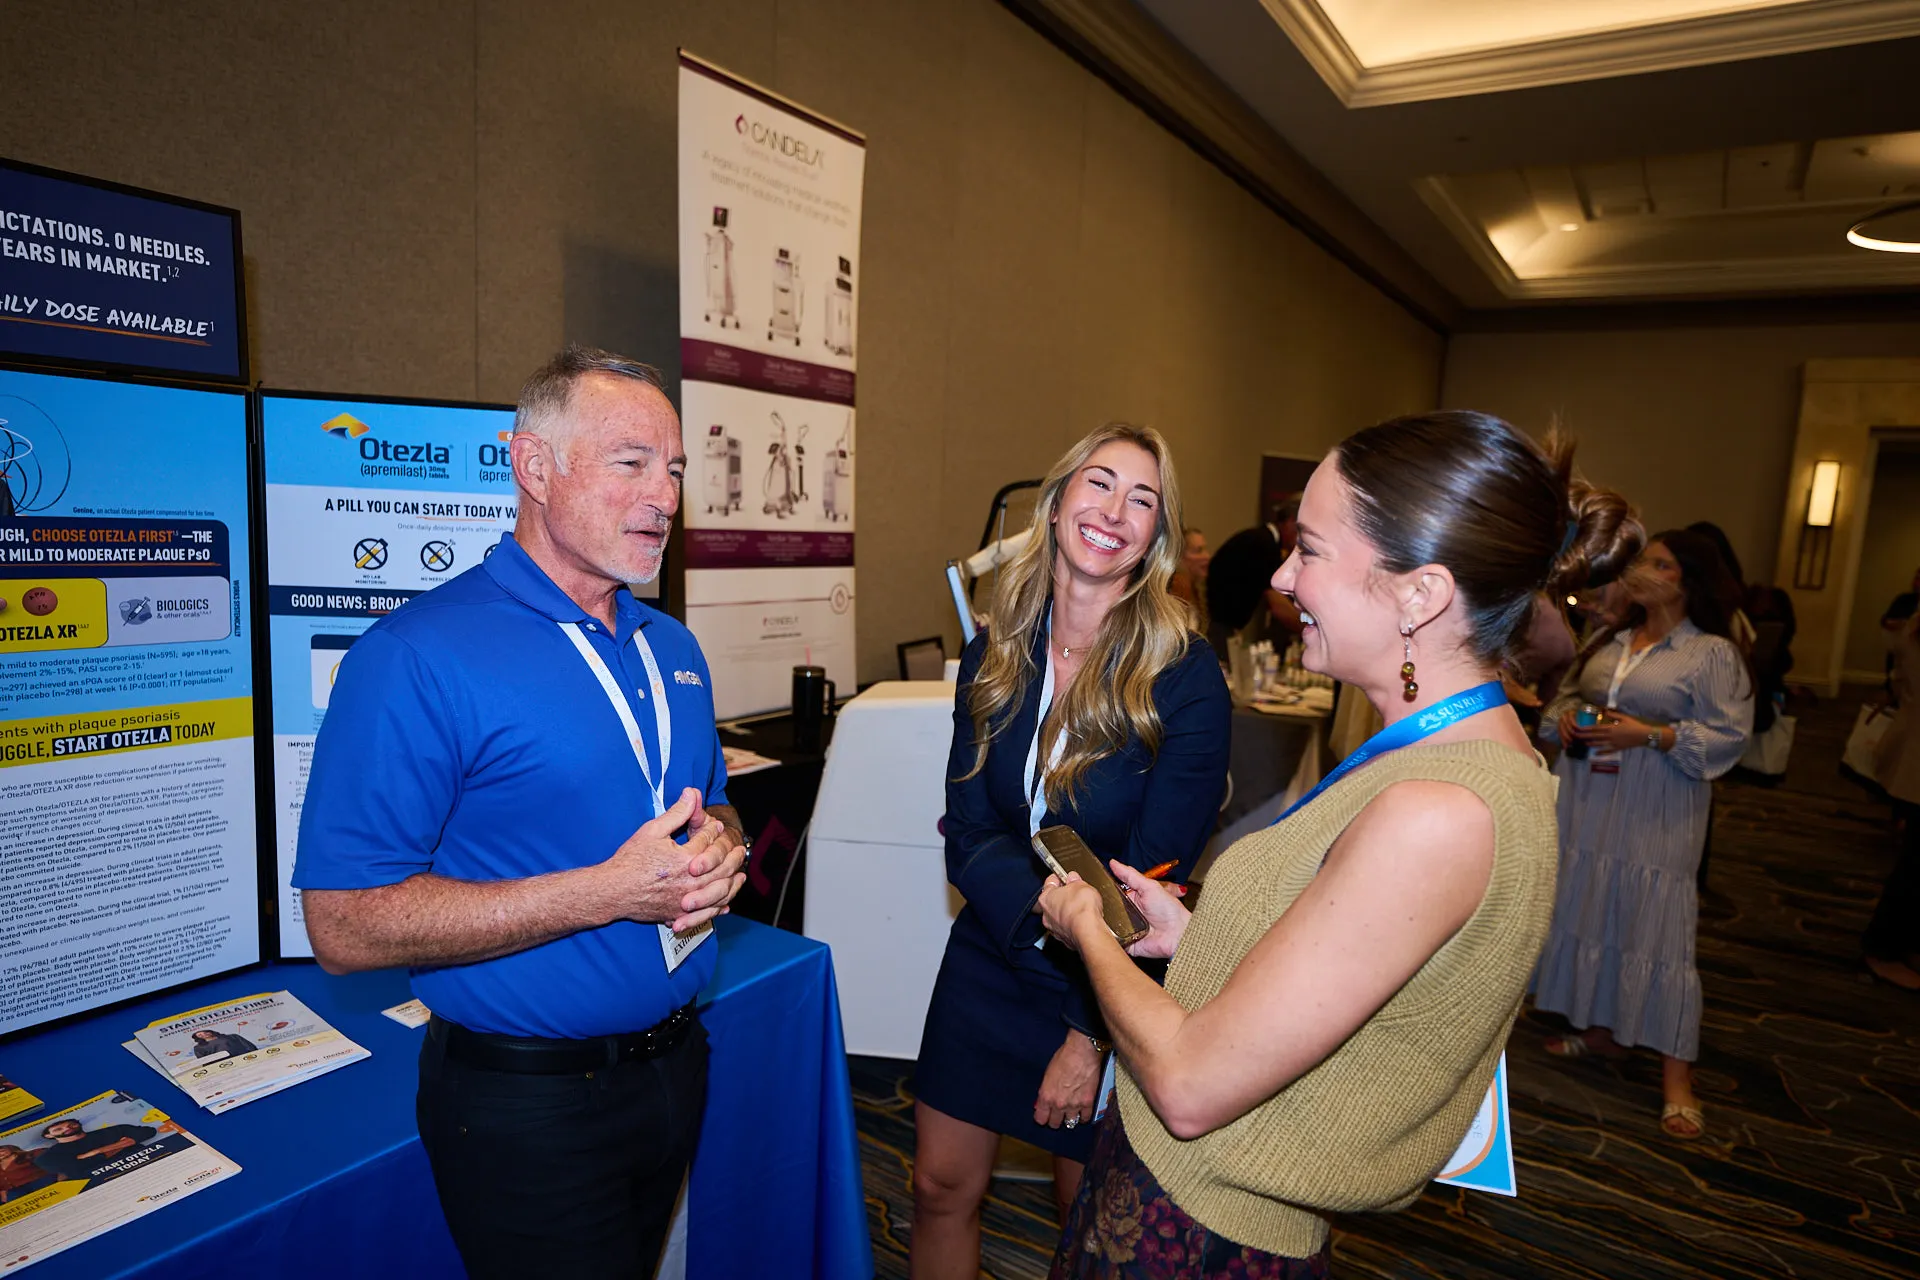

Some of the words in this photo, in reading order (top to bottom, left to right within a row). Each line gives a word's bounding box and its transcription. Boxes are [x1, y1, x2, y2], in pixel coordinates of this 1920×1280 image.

[0, 237, 56, 264] EARS
[60, 248, 81, 269] IN
[129, 234, 211, 266] NEEDLES.
[45, 299, 101, 322] DOSE
[359, 437, 450, 464] Otezla
[360, 463, 427, 480] (apremilast)
[428, 465, 446, 474] 30mg
[324, 498, 335, 511] A
[337, 499, 364, 512] PILL
[367, 500, 391, 513] YOU
[393, 501, 420, 515] CAN
[422, 502, 461, 516] START
[464, 504, 502, 519] TODAY
[32, 528, 87, 543] CHOOSE
[89, 529, 137, 543] OTEZLA
[9, 548, 44, 562] MILD
[46, 548, 64, 562] TO
[67, 548, 136, 561] MODERATE
[138, 548, 186, 561] PLAQUE
[156, 598, 209, 612] BIOLOGICS
[291, 593, 324, 608] GOOD
[327, 594, 367, 609] NEWS:
[164, 611, 181, 619] other
[0, 625, 54, 641] OTEZLA
[7, 660, 27, 669] mild
[29, 659, 38, 668] to
[40, 657, 80, 667] moderate
[82, 655, 109, 665] plaque
[111, 652, 146, 663] psoriasis
[181, 650, 195, 658] age
[79, 665, 98, 673] PASI
[30, 680, 67, 690] achieved
[81, 677, 103, 686] sPGA
[104, 676, 127, 684] score
[128, 674, 136, 682] of
[16, 691, 50, 702] placebo
[85, 687, 93, 695] at
[95, 685, 116, 694] week
[119, 684, 128, 692] 16
[1437, 691, 1486, 720] SUNRISE
[33, 721, 65, 735] with
[69, 718, 117, 734] plaque
[121, 709, 181, 729] psoriasis
[54, 733, 108, 755] START
[111, 727, 170, 748] OTEZLA
[174, 721, 216, 740] TODAY
[2, 784, 18, 792] who
[33, 780, 53, 788] more
[54, 773, 95, 785] susceptible
[104, 767, 150, 778] complications
[158, 760, 185, 770] diarrhea
[16, 867, 55, 879] committed
[16, 1003, 49, 1017] expected
[50, 1000, 65, 1011] may
[66, 994, 83, 1004] need
[84, 992, 92, 1000] to
[92, 988, 109, 997] have
[109, 984, 125, 993] their
[126, 974, 158, 987] treatment
[160, 1019, 197, 1033] START
[199, 1006, 243, 1021] OTEZLA
[243, 998, 276, 1011] FIRST
[91, 1159, 125, 1176] START
[125, 1143, 165, 1161] OTEZLA
[115, 1155, 151, 1172] TODAY
[4, 1206, 21, 1215] SEE
[23, 1190, 62, 1207] TOPICAL
